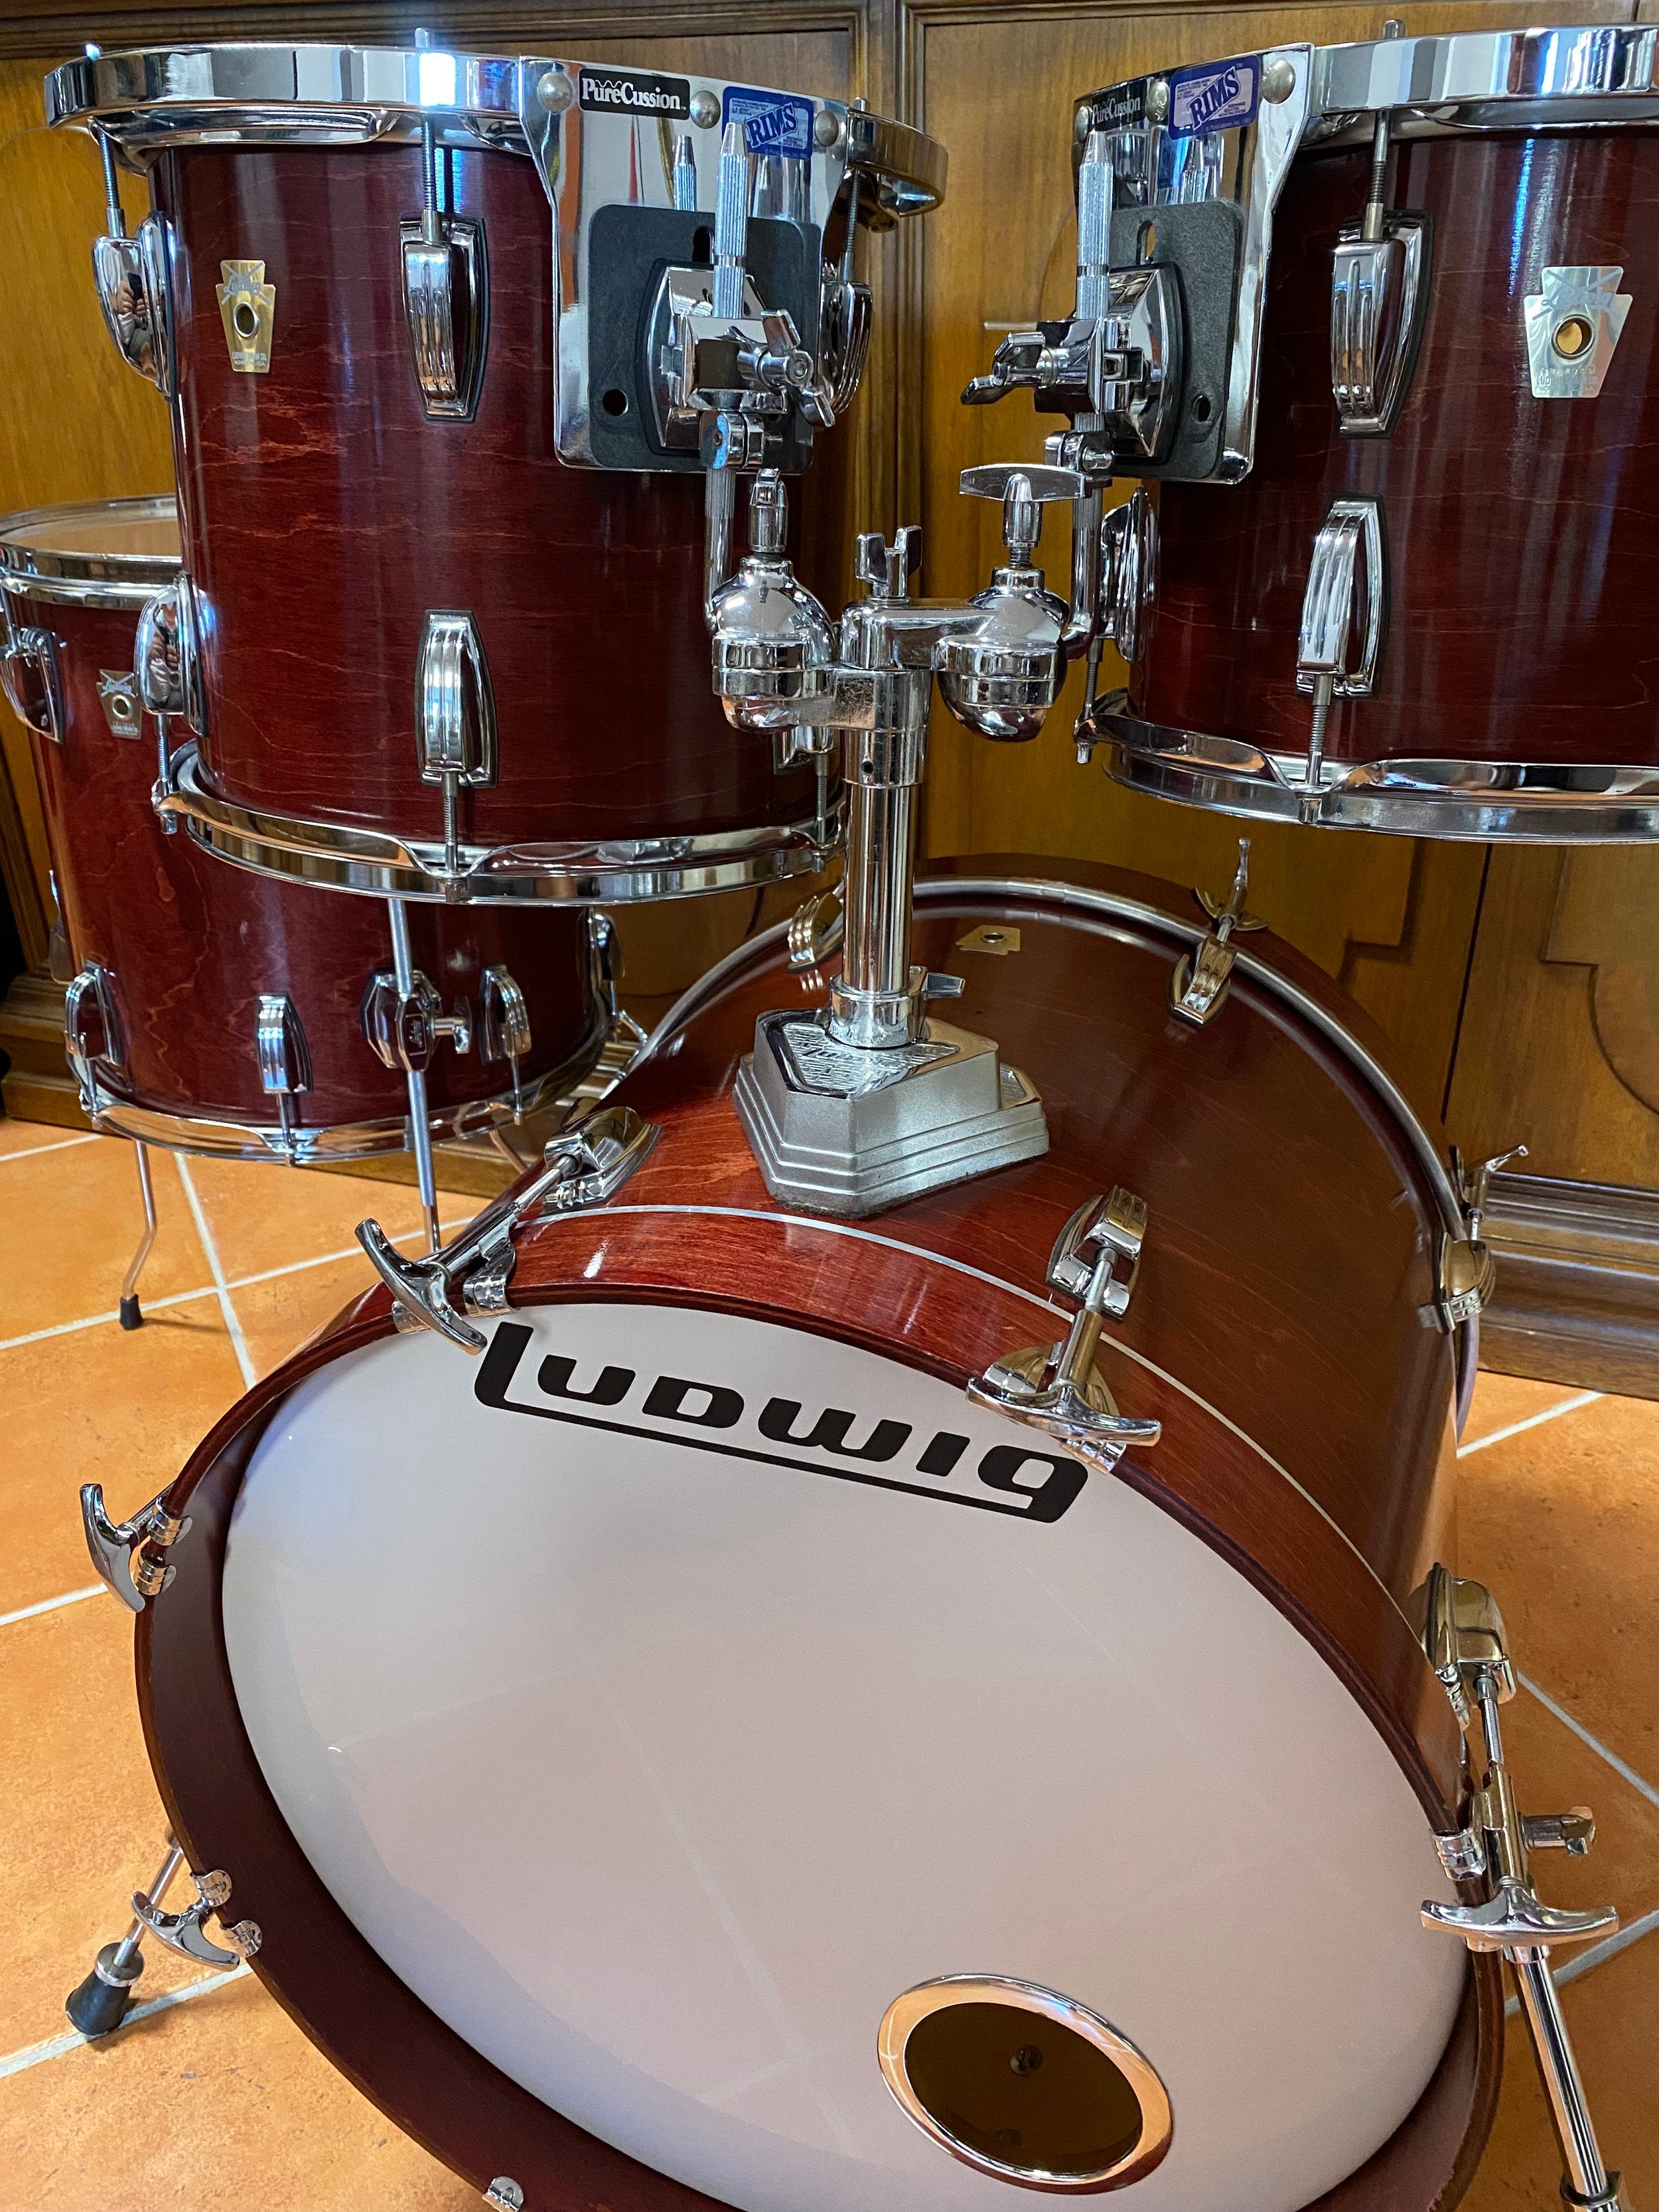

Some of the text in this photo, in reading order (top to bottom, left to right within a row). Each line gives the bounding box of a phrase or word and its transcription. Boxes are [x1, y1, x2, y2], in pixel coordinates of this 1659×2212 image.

[581, 78, 681, 110] PureCussion
[1189, 66, 1240, 131] RIMS
[745, 103, 797, 148] RIMS
